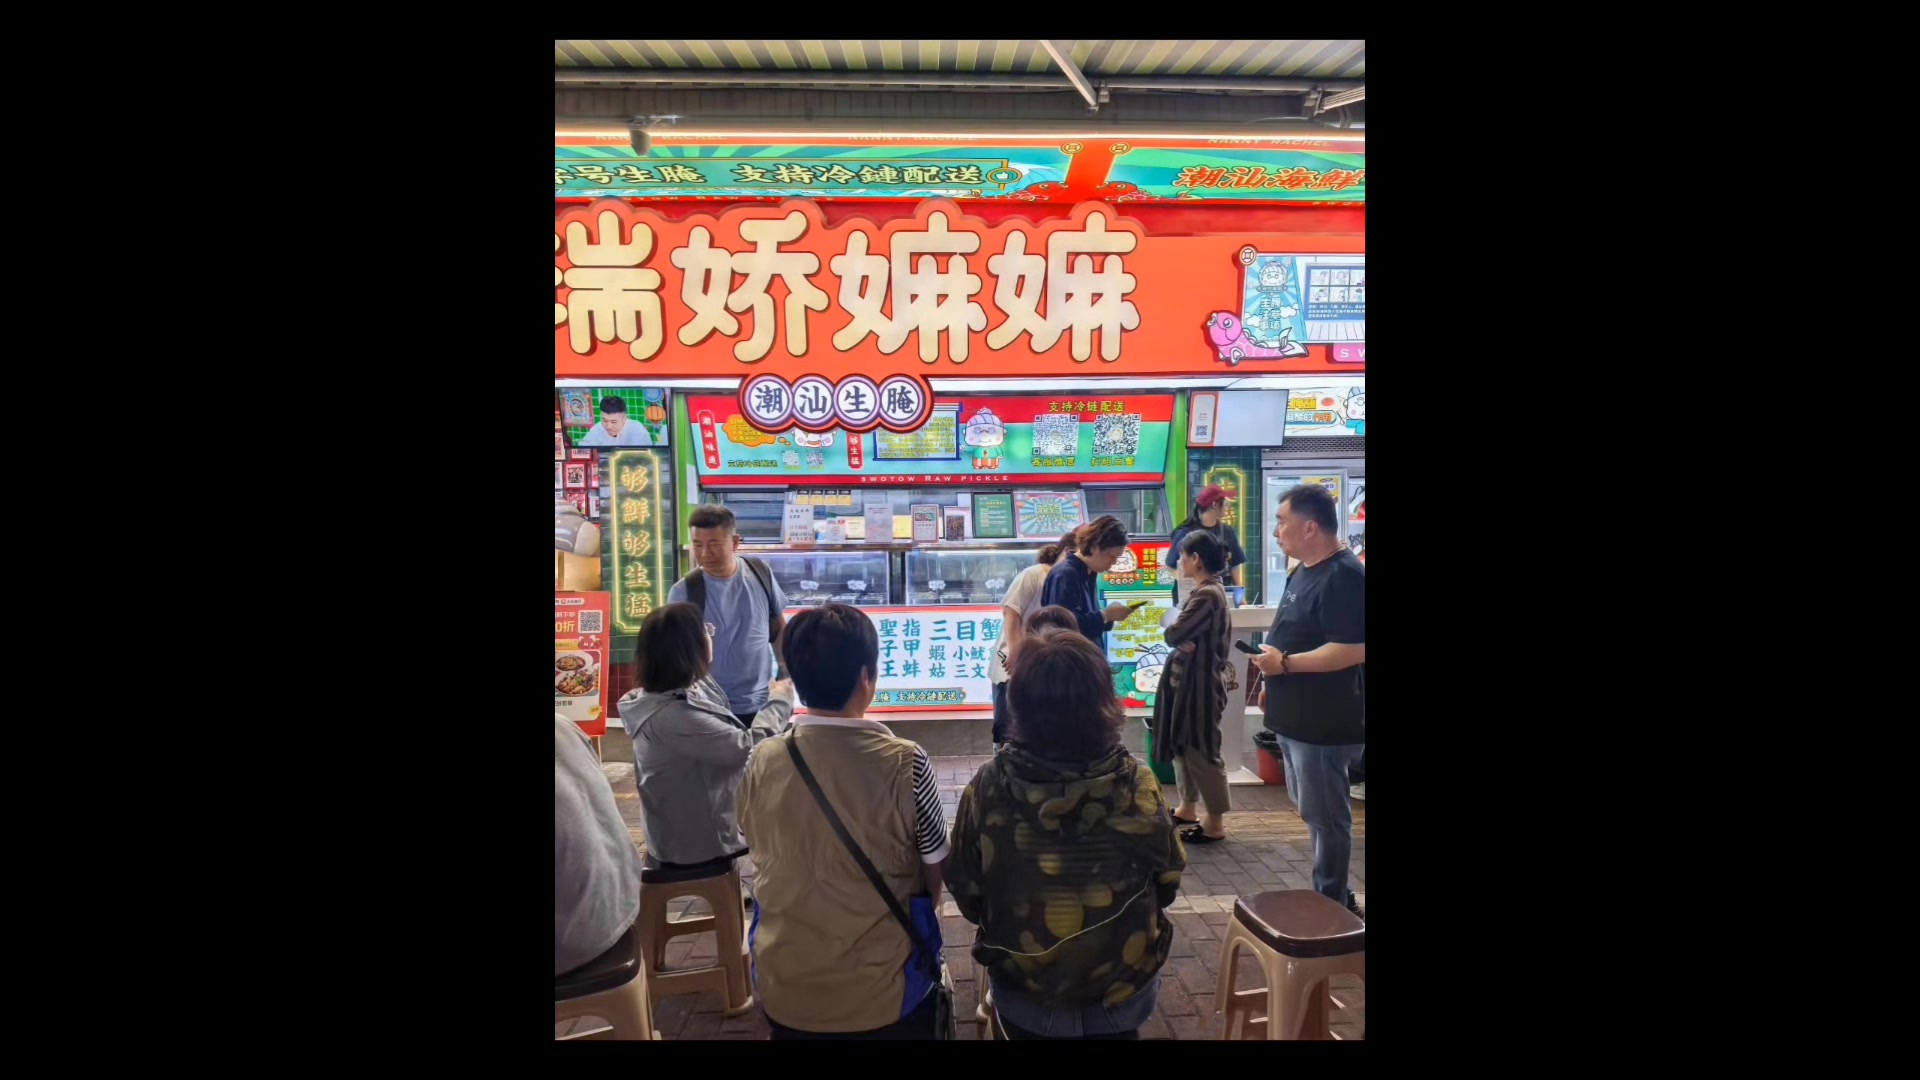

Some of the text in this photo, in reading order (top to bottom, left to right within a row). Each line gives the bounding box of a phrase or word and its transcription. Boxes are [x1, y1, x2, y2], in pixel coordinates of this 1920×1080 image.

[734, 163, 984, 185] 支持冷鏈配送
[754, 384, 915, 414] 潮汕生腌
[1049, 401, 1125, 412] 支持冷链配送
[953, 645, 993, 661] 小魷
